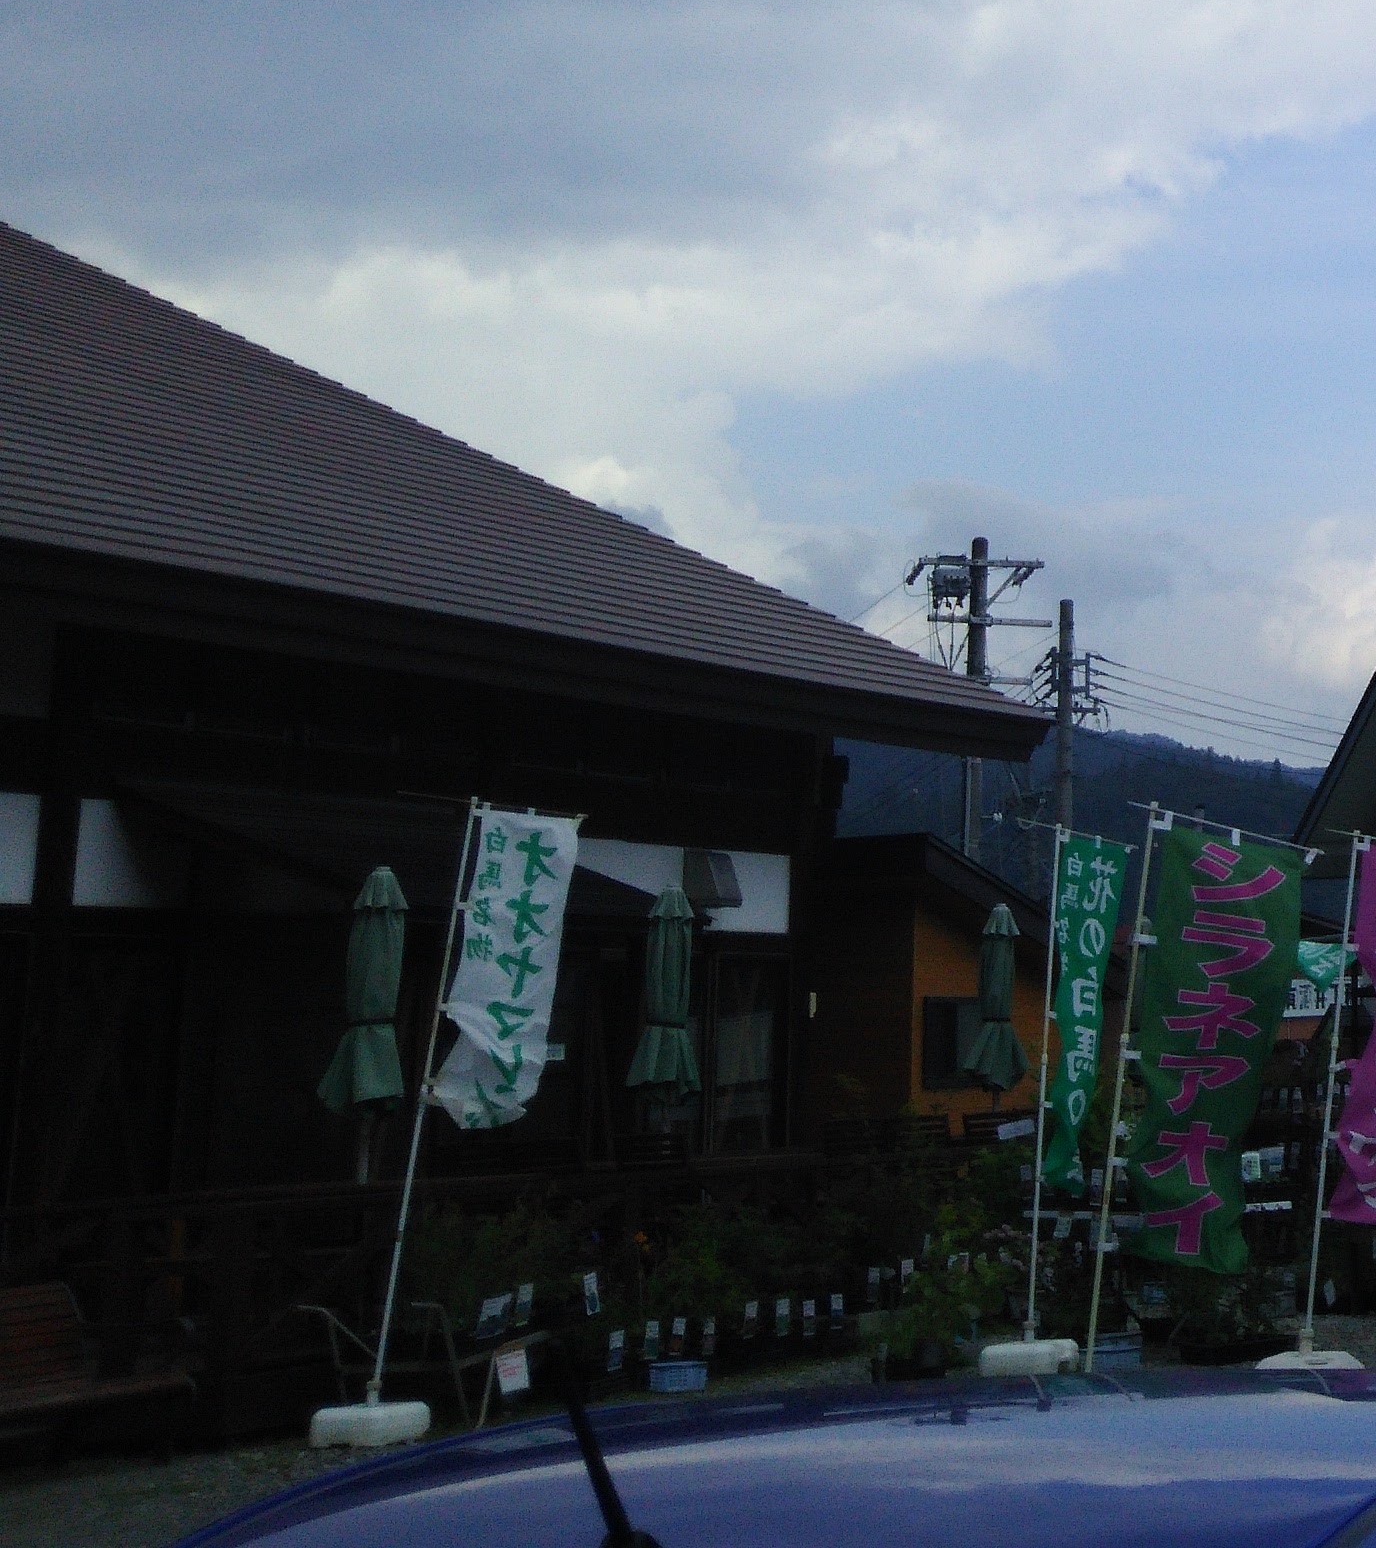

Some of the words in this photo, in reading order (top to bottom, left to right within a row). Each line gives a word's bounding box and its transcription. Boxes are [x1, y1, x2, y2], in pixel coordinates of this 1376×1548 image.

[1140, 841, 1287, 1256] シラネアオイ
